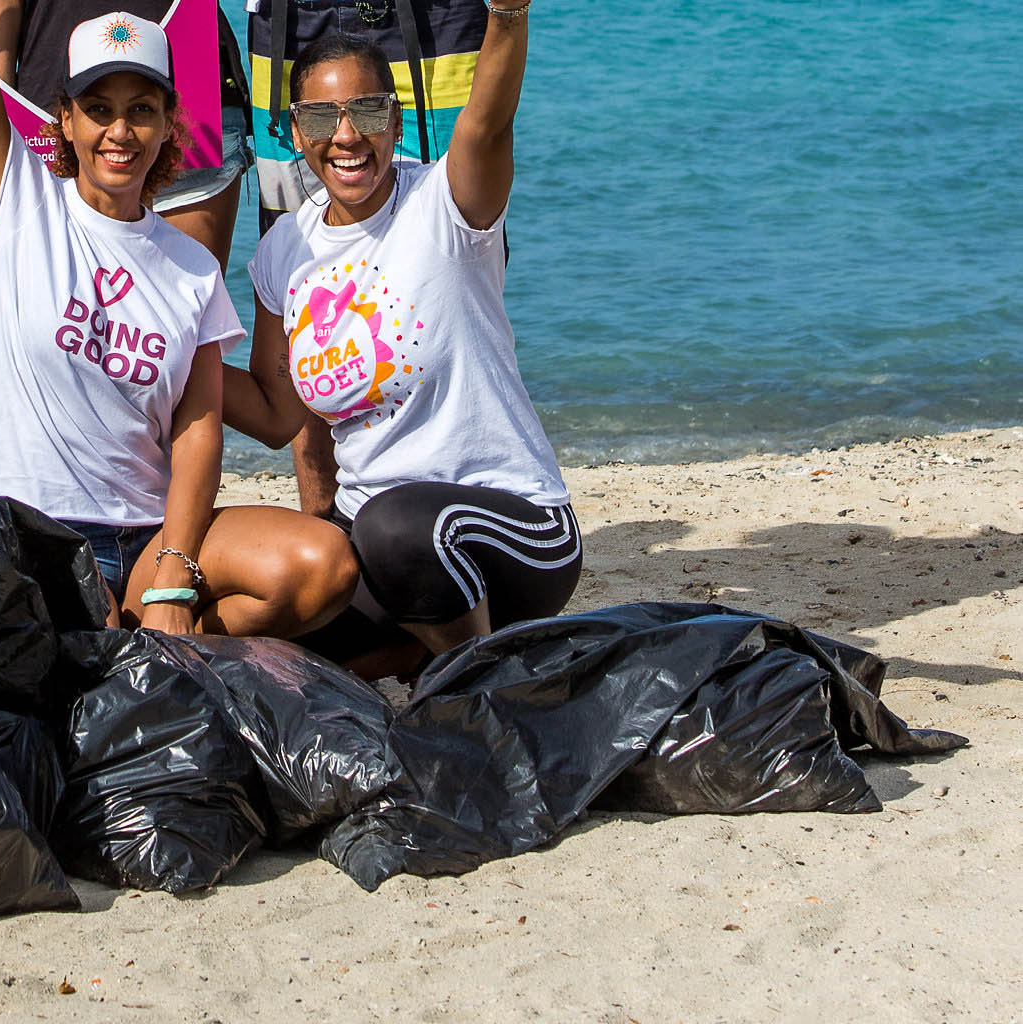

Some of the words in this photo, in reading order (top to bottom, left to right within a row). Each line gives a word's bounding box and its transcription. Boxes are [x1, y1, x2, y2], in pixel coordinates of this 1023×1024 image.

[24, 135, 57, 147] icture
[63, 295, 167, 361] DOING
[55, 324, 159, 387] GOOD
[297, 337, 360, 379] CURA
[297, 355, 368, 402] DOET
